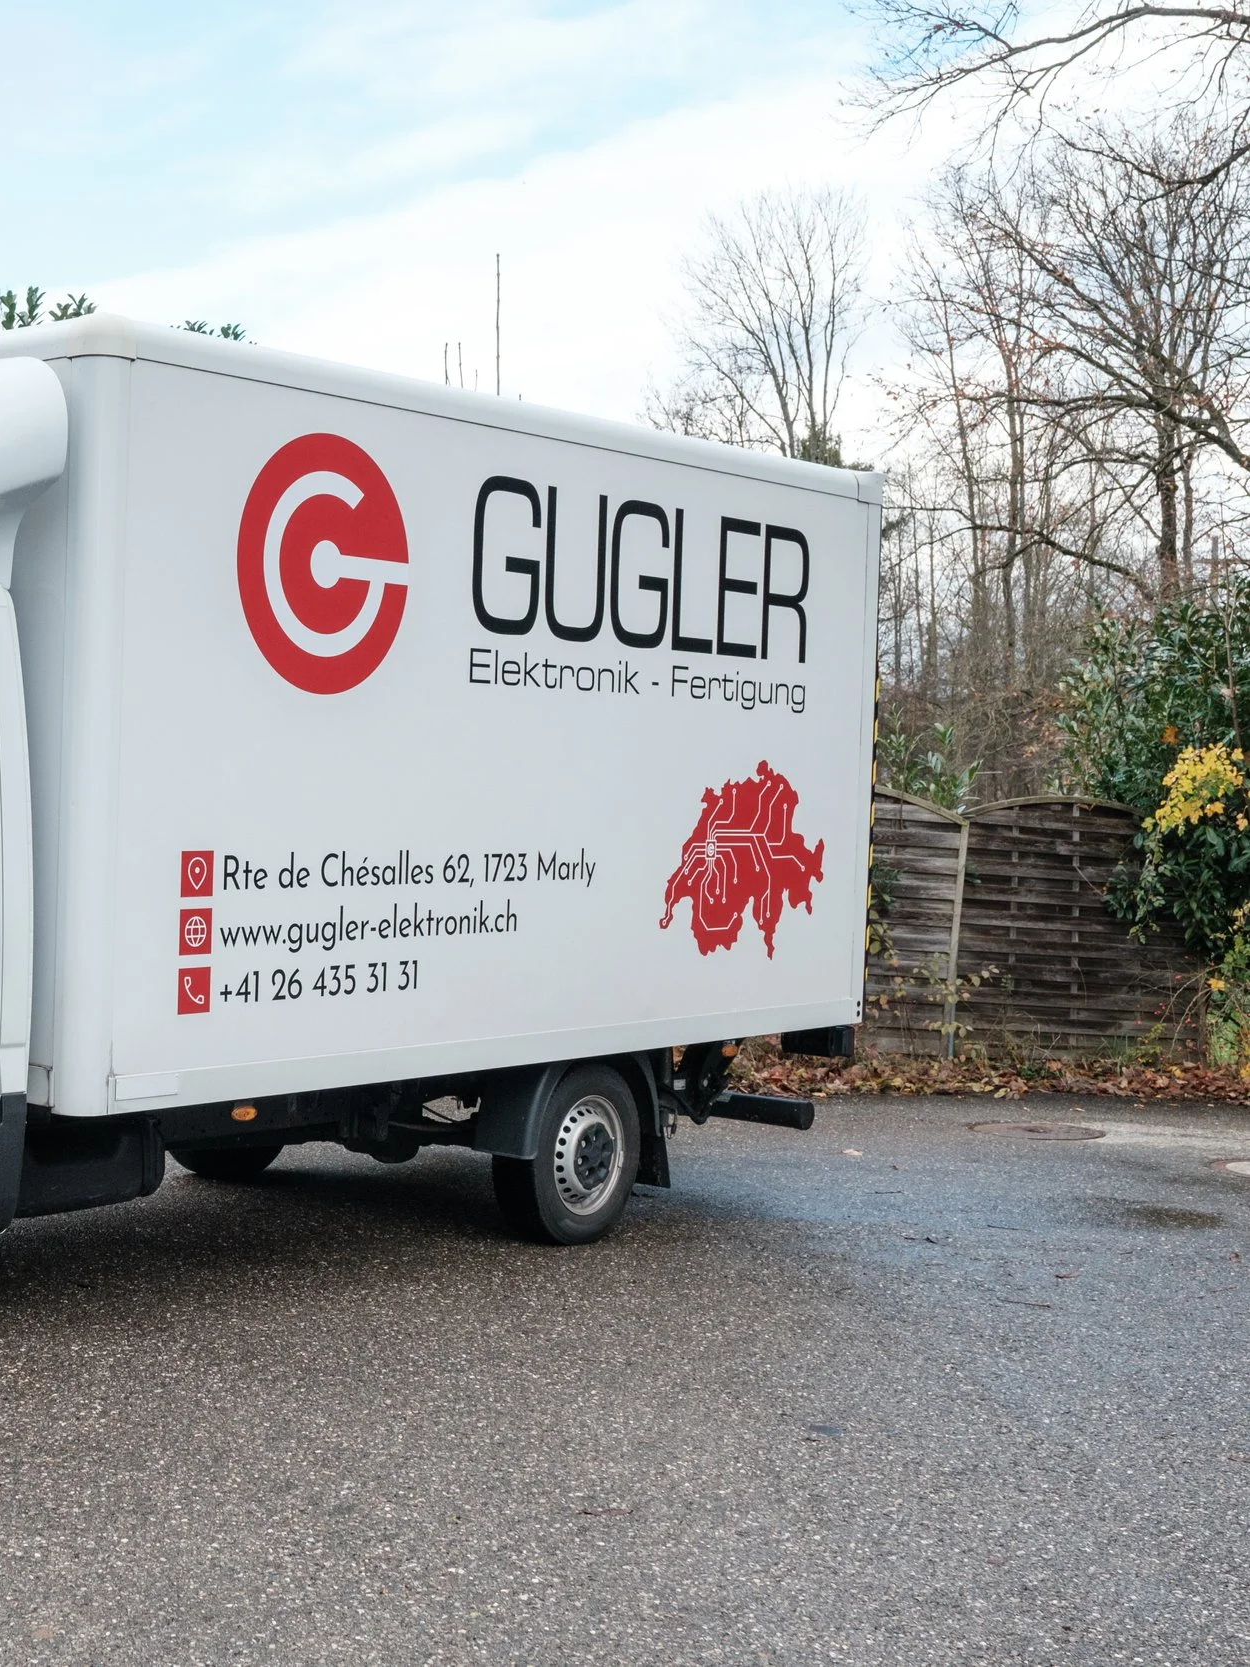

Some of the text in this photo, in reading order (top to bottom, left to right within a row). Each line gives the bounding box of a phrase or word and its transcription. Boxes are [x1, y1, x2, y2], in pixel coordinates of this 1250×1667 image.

[471, 475, 811, 664] GUGLER
[468, 648, 640, 695] Elektronik
[670, 665, 807, 714] Fertigung
[222, 847, 597, 891] Rte de Chésalles 62, 1723 Marly
[219, 898, 519, 954] www.gugler-elektronik.ch
[219, 959, 419, 1004] +41 26 435 31 31
